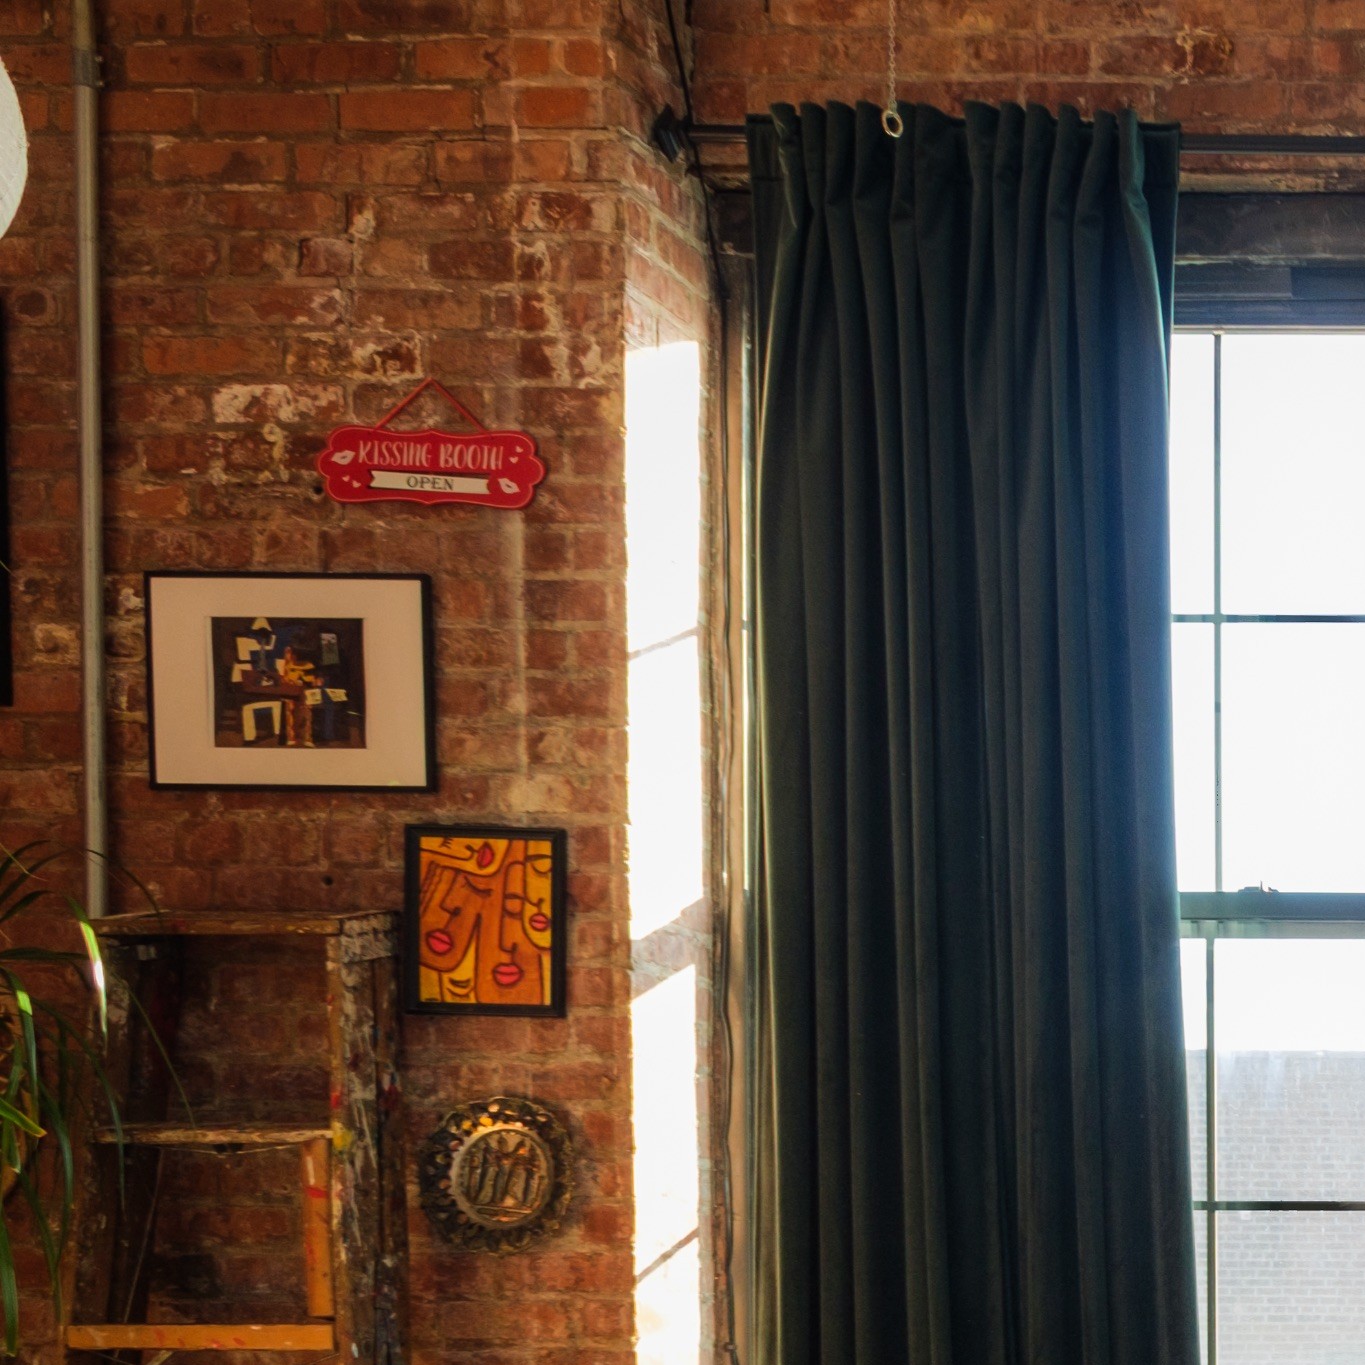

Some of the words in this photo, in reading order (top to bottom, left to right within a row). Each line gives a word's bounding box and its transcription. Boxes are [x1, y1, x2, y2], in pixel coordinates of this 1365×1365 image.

[358, 440, 432, 467] KISSING
[440, 443, 504, 470] BOOTH
[406, 475, 455, 491] OPEN
